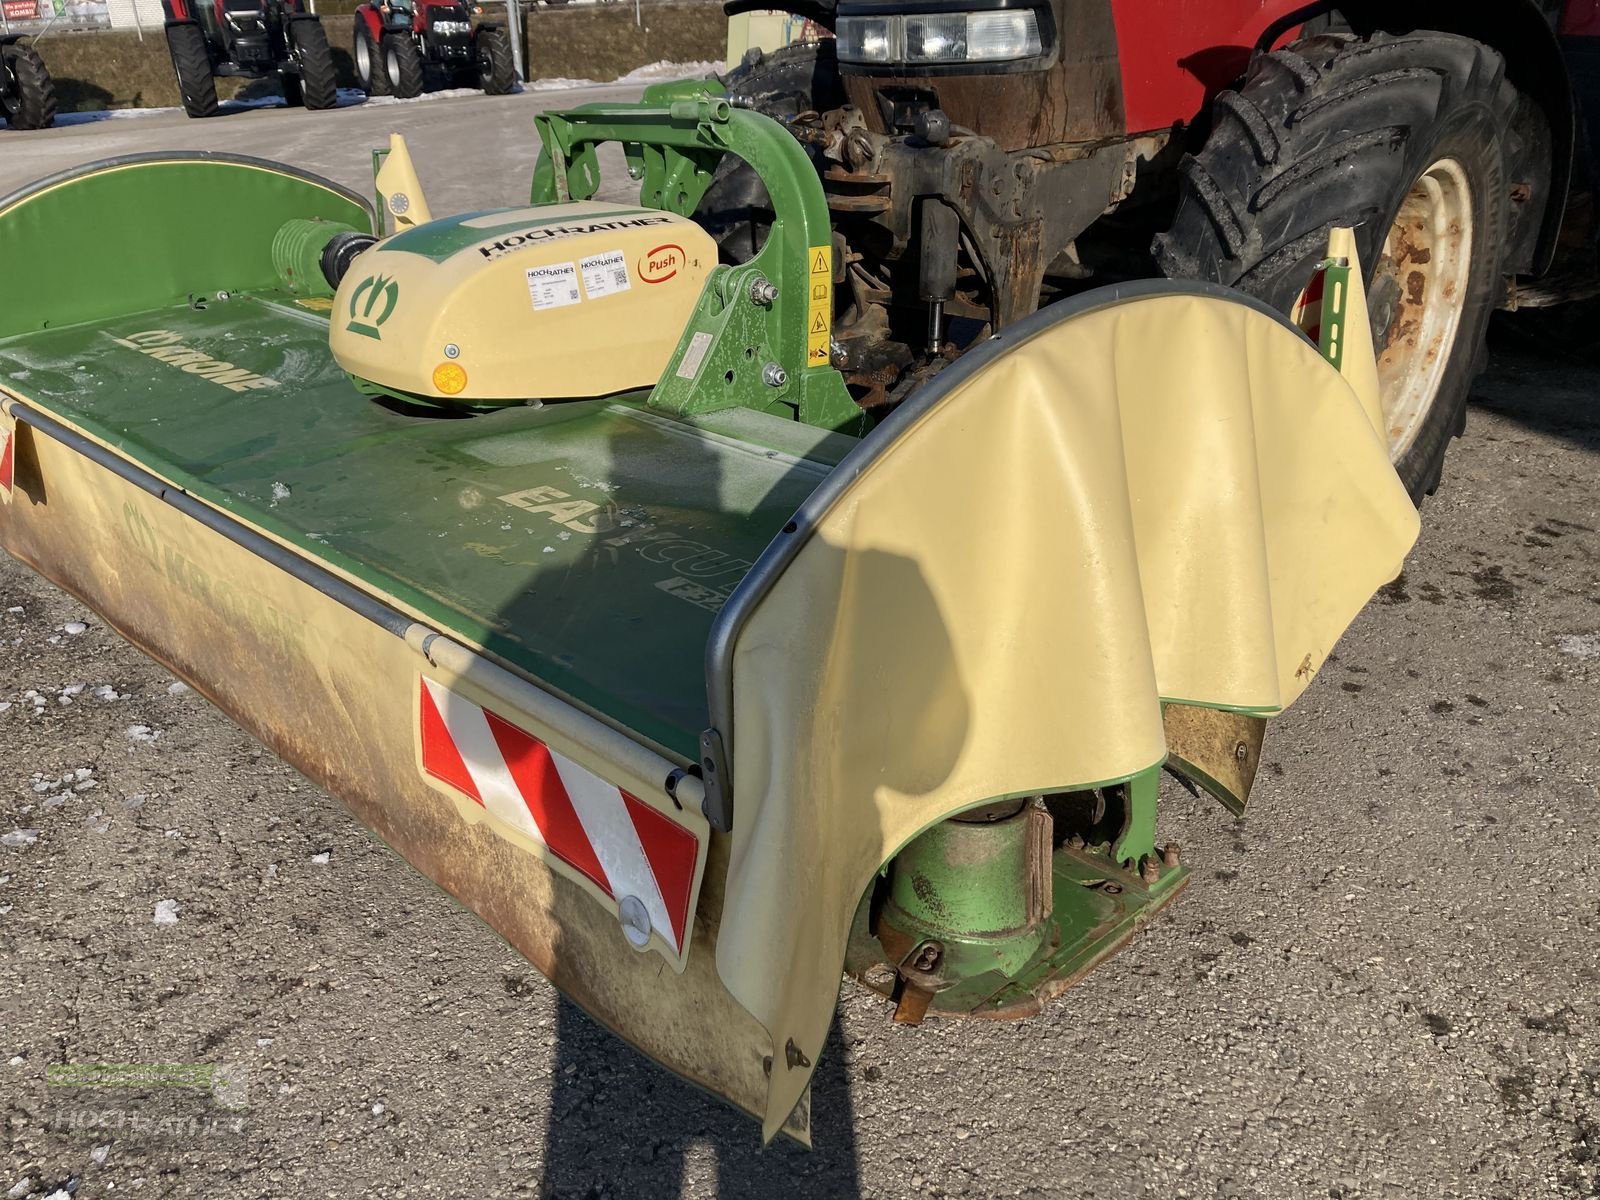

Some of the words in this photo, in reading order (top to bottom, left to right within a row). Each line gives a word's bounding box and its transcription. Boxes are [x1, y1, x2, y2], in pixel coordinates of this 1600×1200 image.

[479, 218, 674, 257] HOCHRATHER
[527, 266, 574, 277] HOCHRATHER
[581, 255, 624, 270] HOCHRATHER
[648, 253, 676, 273] Push
[139, 345, 282, 393] KRONE
